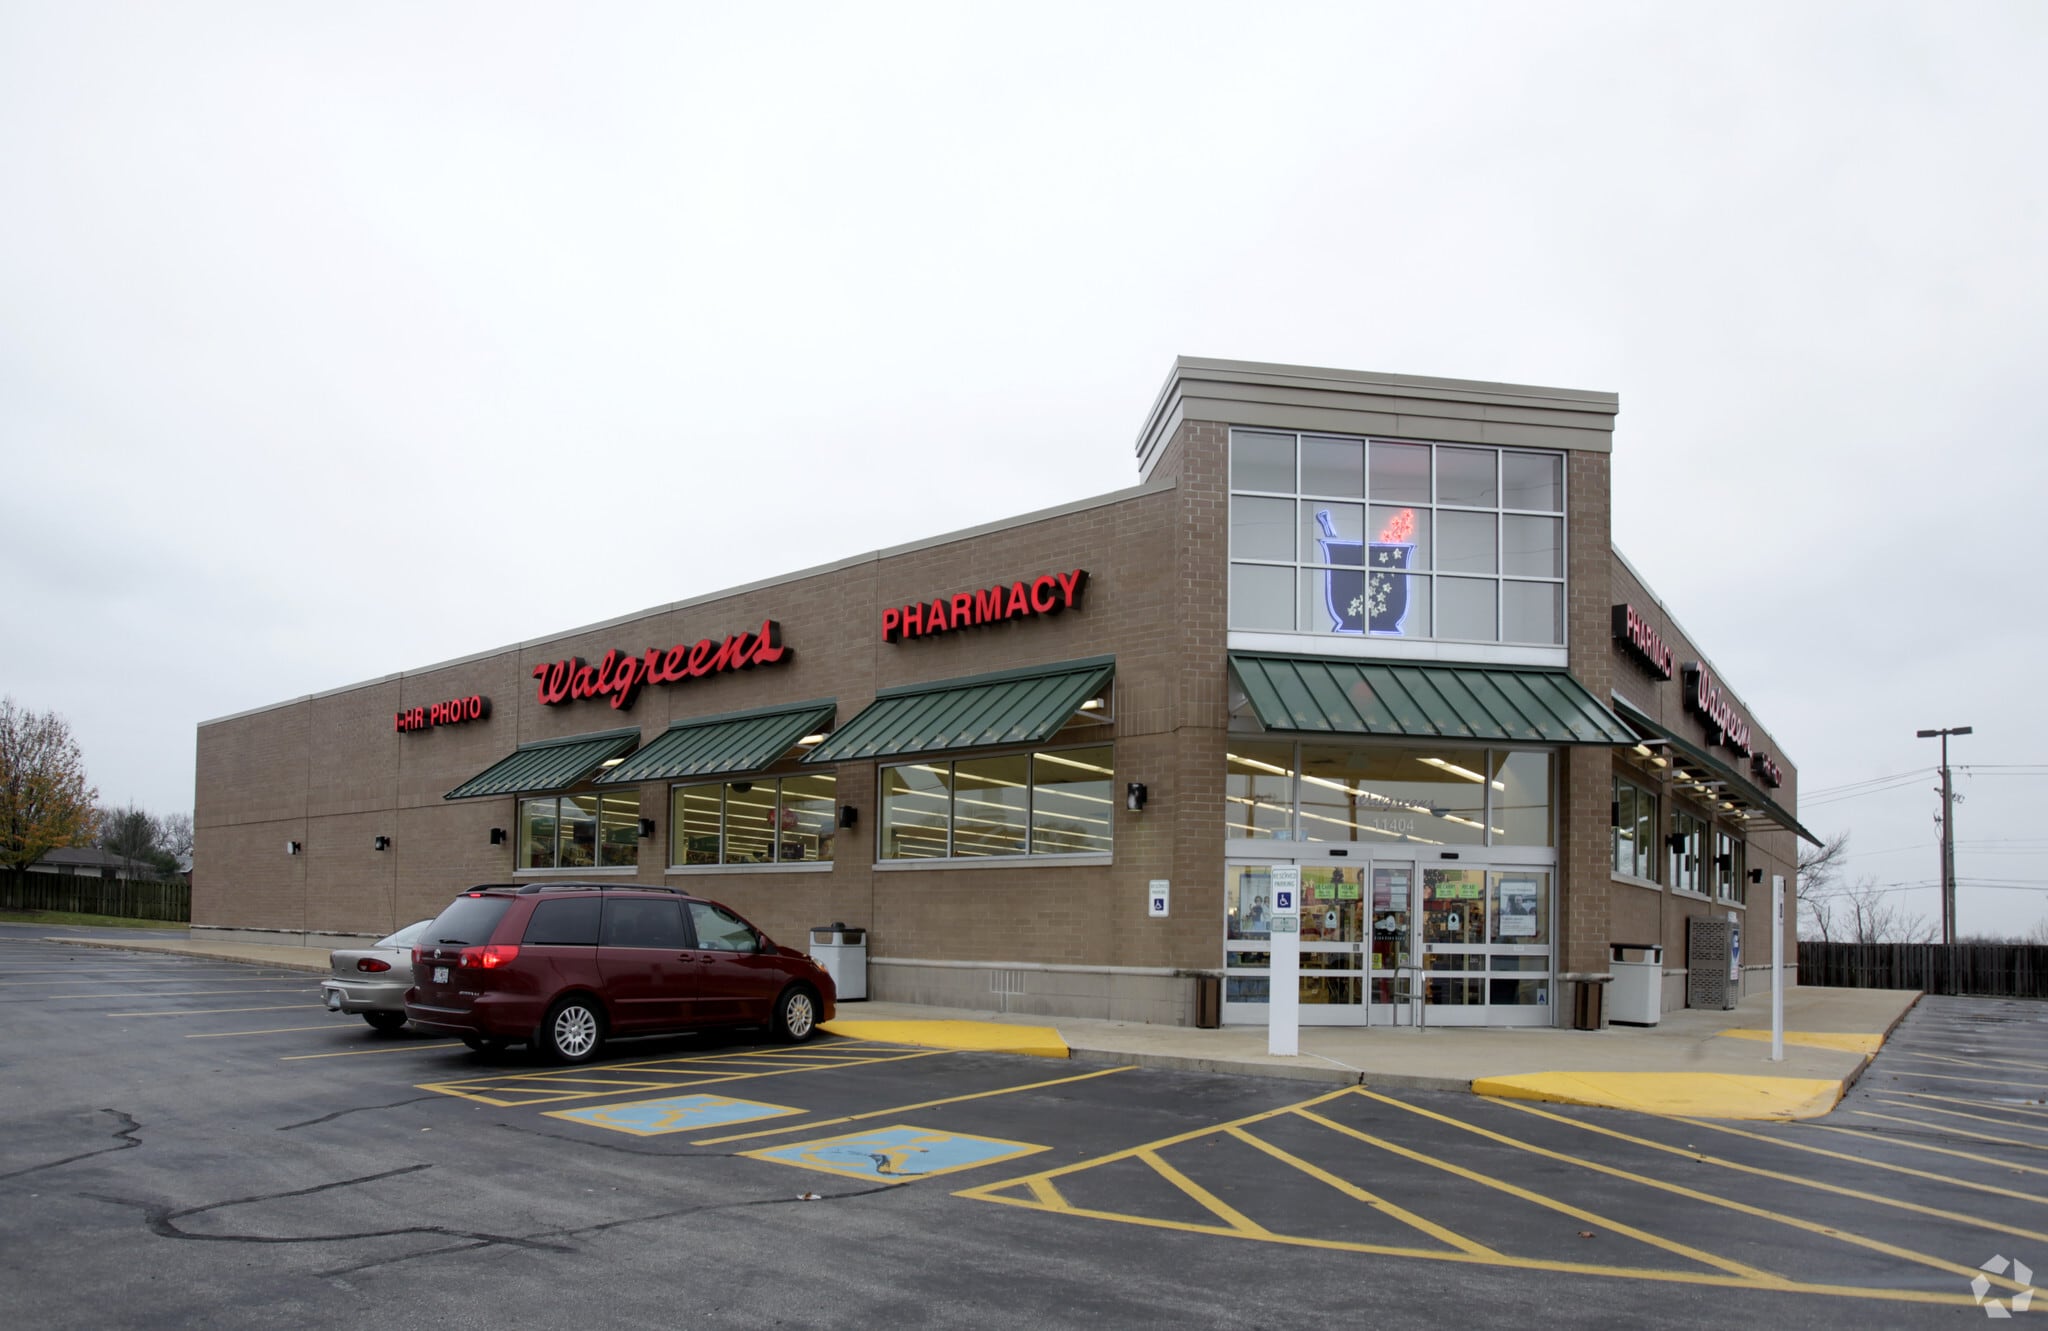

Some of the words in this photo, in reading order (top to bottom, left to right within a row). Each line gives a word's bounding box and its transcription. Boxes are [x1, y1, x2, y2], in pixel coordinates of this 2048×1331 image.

[881, 569, 1084, 643] PHARMACY
[1626, 604, 1675, 678] PHARMACY
[532, 620, 786, 710] Walgreens
[393, 707, 424, 732] 1-HR
[430, 695, 482, 726] PHOTO
[1696, 661, 1753, 757] Walgreens
[1374, 818, 1415, 832] 11404
